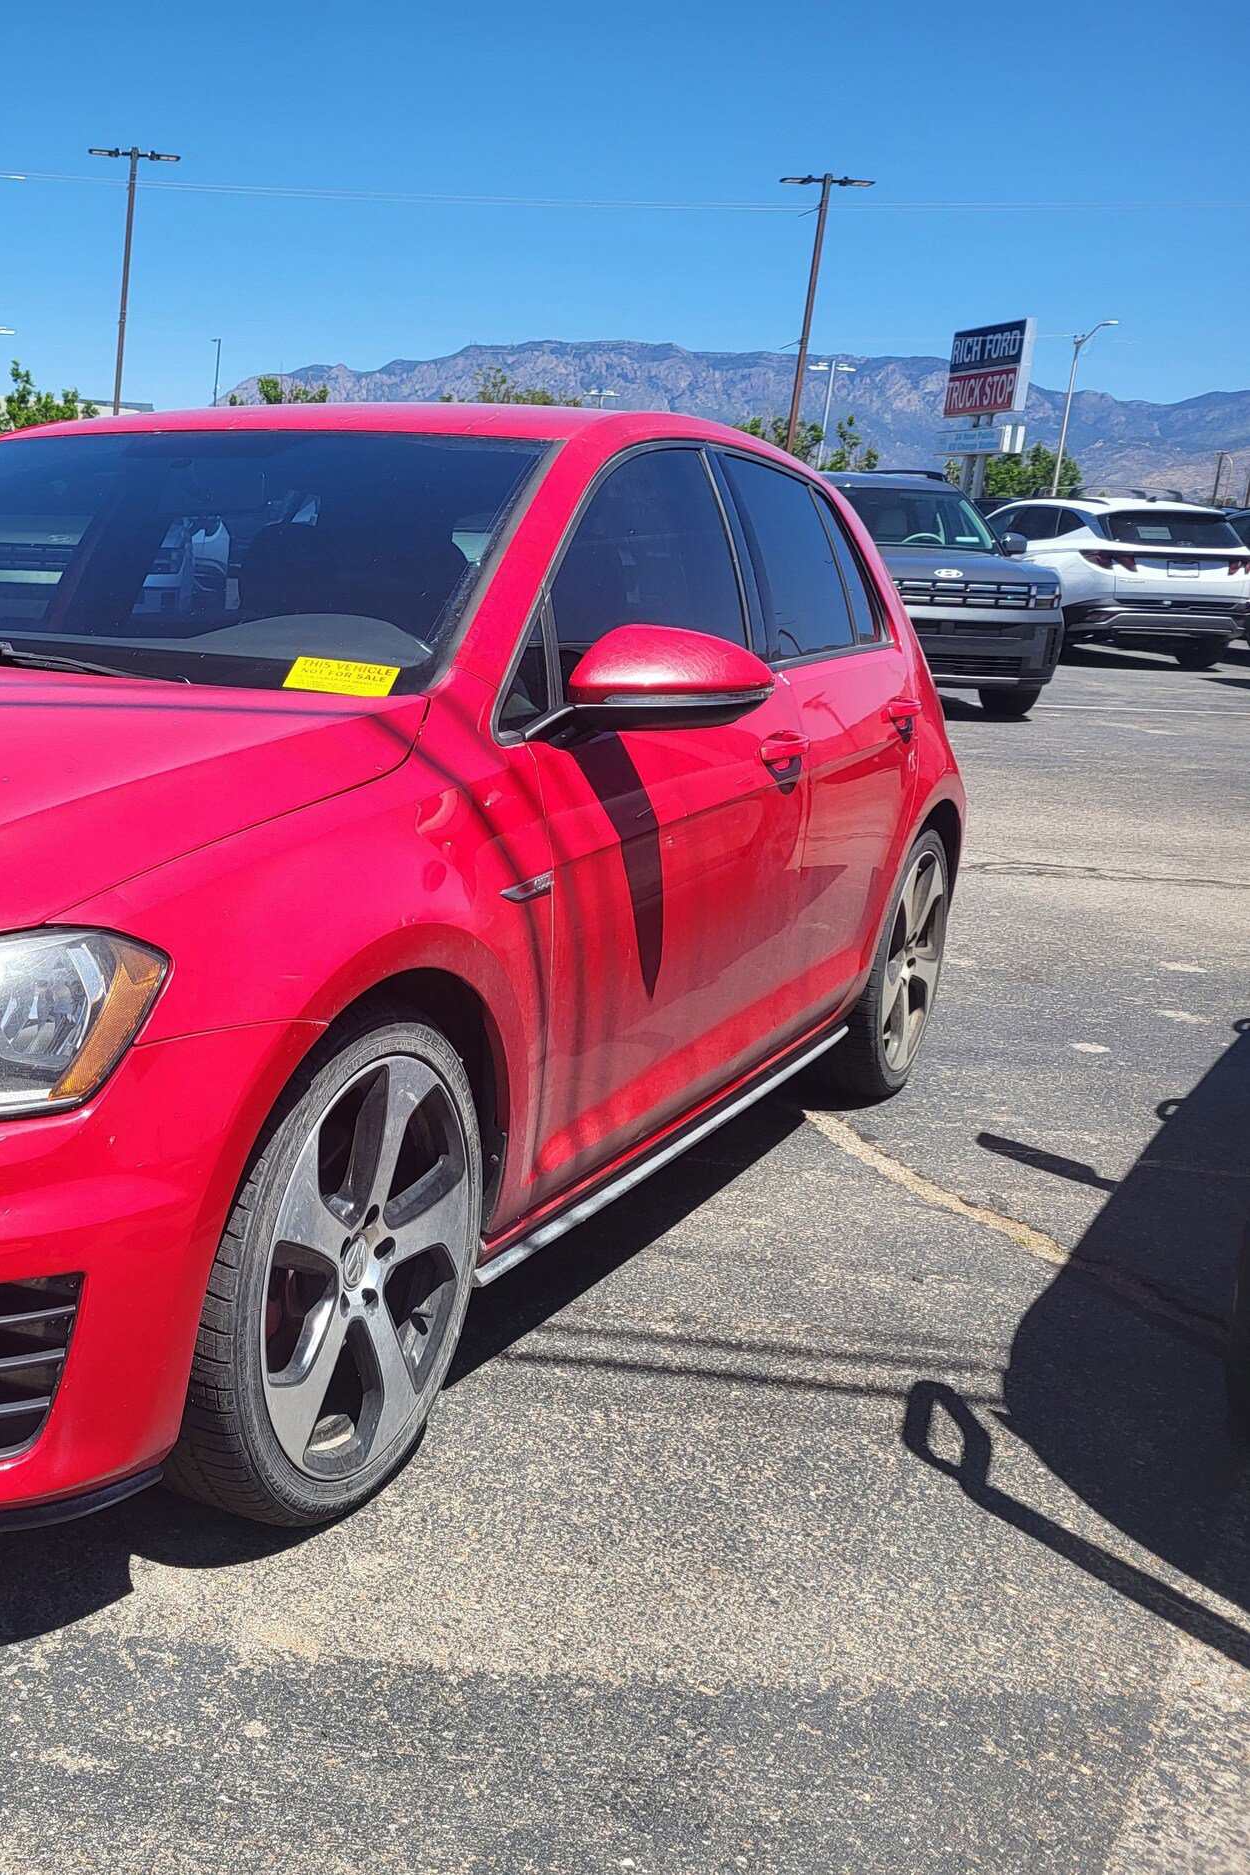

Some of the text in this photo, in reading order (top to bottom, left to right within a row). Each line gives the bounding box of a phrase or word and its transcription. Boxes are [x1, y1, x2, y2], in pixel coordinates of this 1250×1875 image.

[952, 329, 1021, 365] RICH FORD
[946, 373, 1016, 410] TRUCK STOP
[301, 667, 387, 683] NOT FOR SALE
[303, 659, 394, 677] THIS VEHICLE
